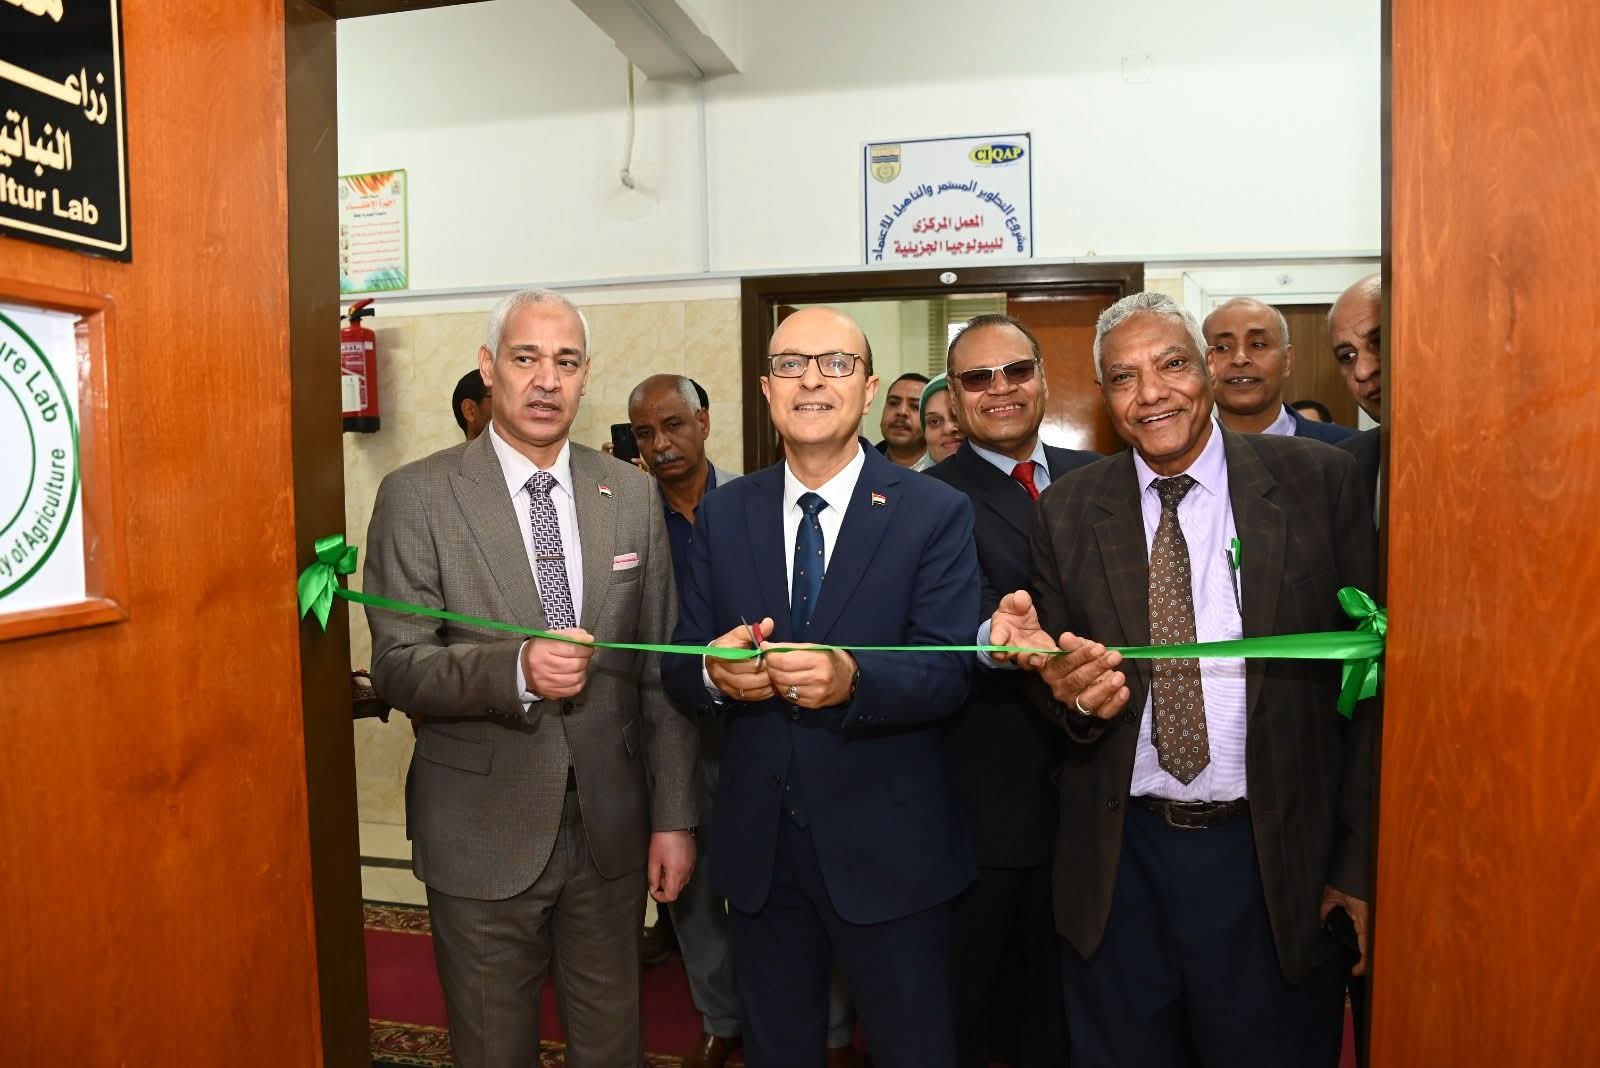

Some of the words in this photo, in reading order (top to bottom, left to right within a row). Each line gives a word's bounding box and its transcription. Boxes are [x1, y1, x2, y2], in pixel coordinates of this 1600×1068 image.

[0, 59, 108, 125] زراع
[0, 109, 73, 177] النباتي
[0, 172, 46, 212] ltur
[52, 188, 99, 225] Lab
[937, 179, 978, 195] المستمر
[976, 189, 1016, 217] التطوير
[945, 236, 1004, 255] للبيولوجيا
[954, 214, 984, 232] المعمل
[1005, 216, 1026, 253] مشروع
[25, 369, 59, 422] Lab
[11, 538, 28, 564] of
[22, 447, 67, 551] Agriculture
